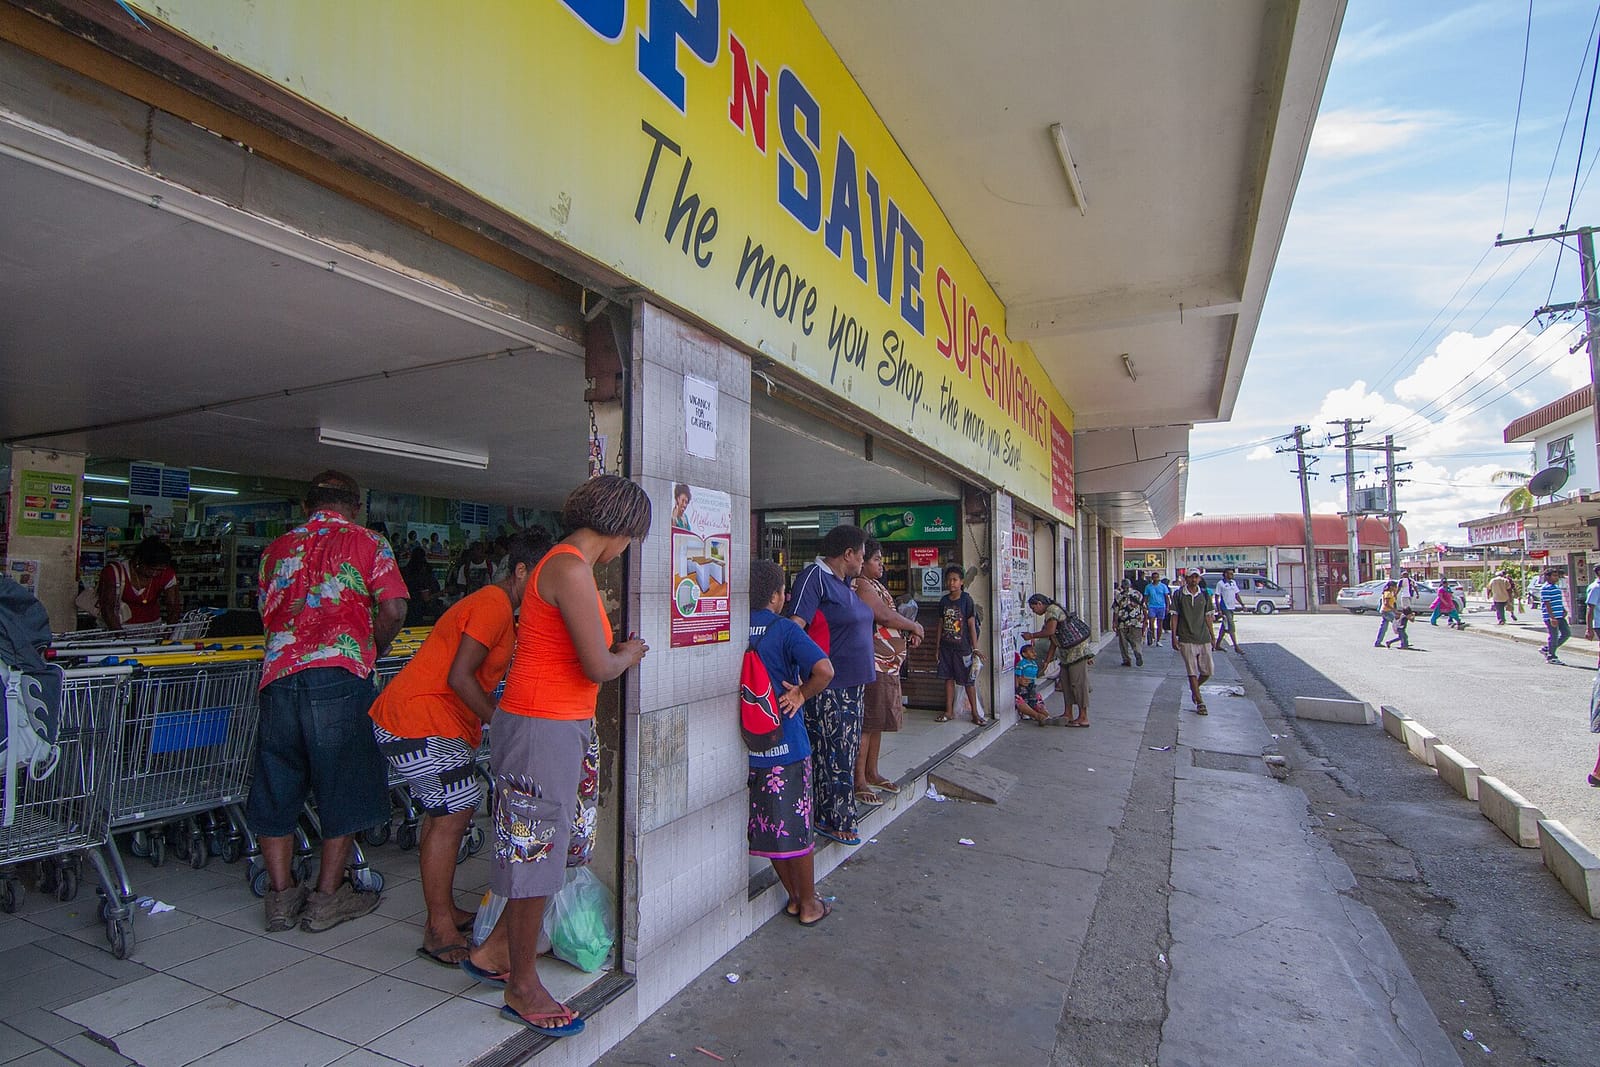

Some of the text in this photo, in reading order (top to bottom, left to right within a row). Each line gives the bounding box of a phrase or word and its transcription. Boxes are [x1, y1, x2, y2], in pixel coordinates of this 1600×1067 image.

[728, 29, 769, 154] N
[776, 66, 925, 338] SAVE
[936, 266, 1048, 452] SUPERMARKET
[634, 118, 719, 269] The
[735, 236, 818, 337] more
[827, 305, 869, 386] you
[877, 329, 932, 421] Shop...
[940, 375, 959, 431] the
[962, 406, 985, 449] more
[987, 426, 1001, 470] you
[695, 407, 705, 419] FOR
[53, 484, 72, 492] VISA
[924, 525, 953, 533] Heineken
[1474, 522, 1516, 543] PAPER POWER
